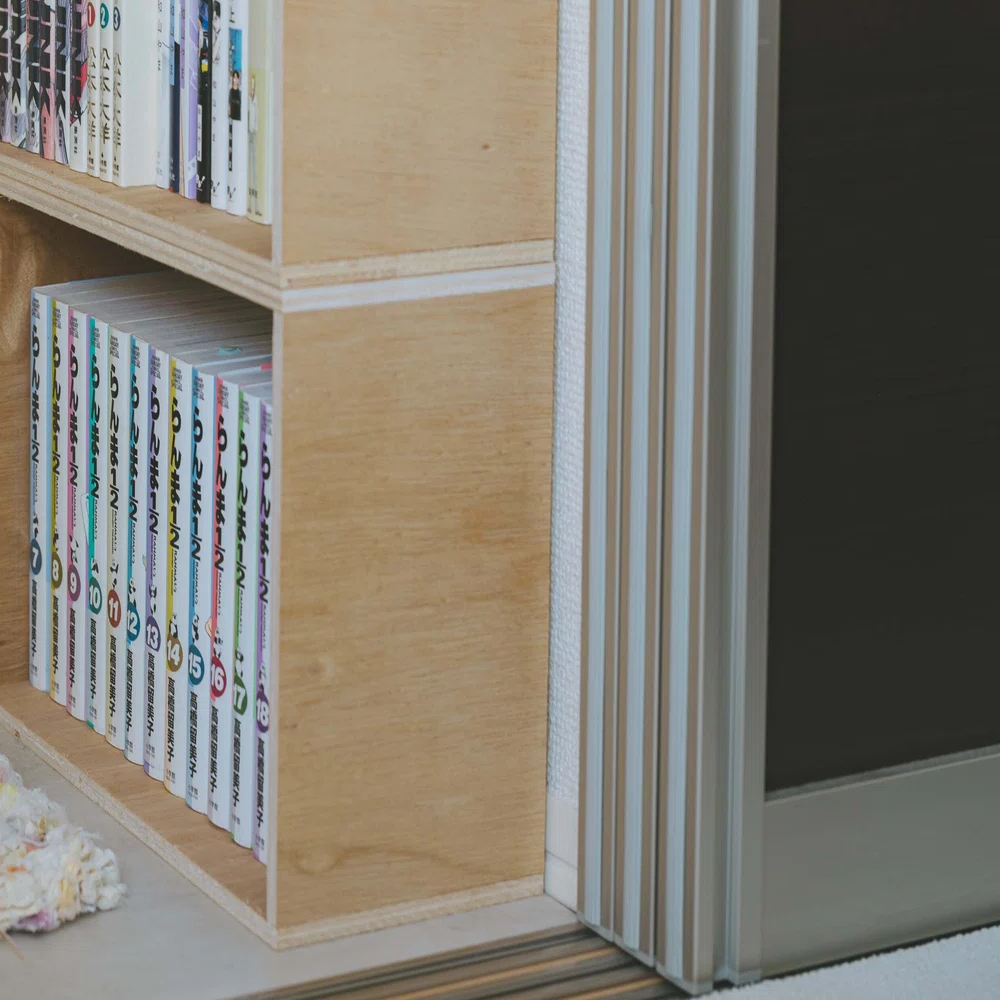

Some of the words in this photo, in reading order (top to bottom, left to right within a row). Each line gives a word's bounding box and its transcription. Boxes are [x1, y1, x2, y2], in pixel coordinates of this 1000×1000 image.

[31, 546, 39, 568] 7
[52, 559, 60, 581] 8
[69, 572, 77, 594] 9
[89, 584, 100, 607] 10
[109, 597, 118, 620] 11
[127, 610, 138, 634] 12
[146, 623, 159, 645] 13
[167, 641, 179, 667] 14
[188, 654, 201, 680] 15
[211, 666, 224, 691] 16
[256, 701, 269, 726] 18
